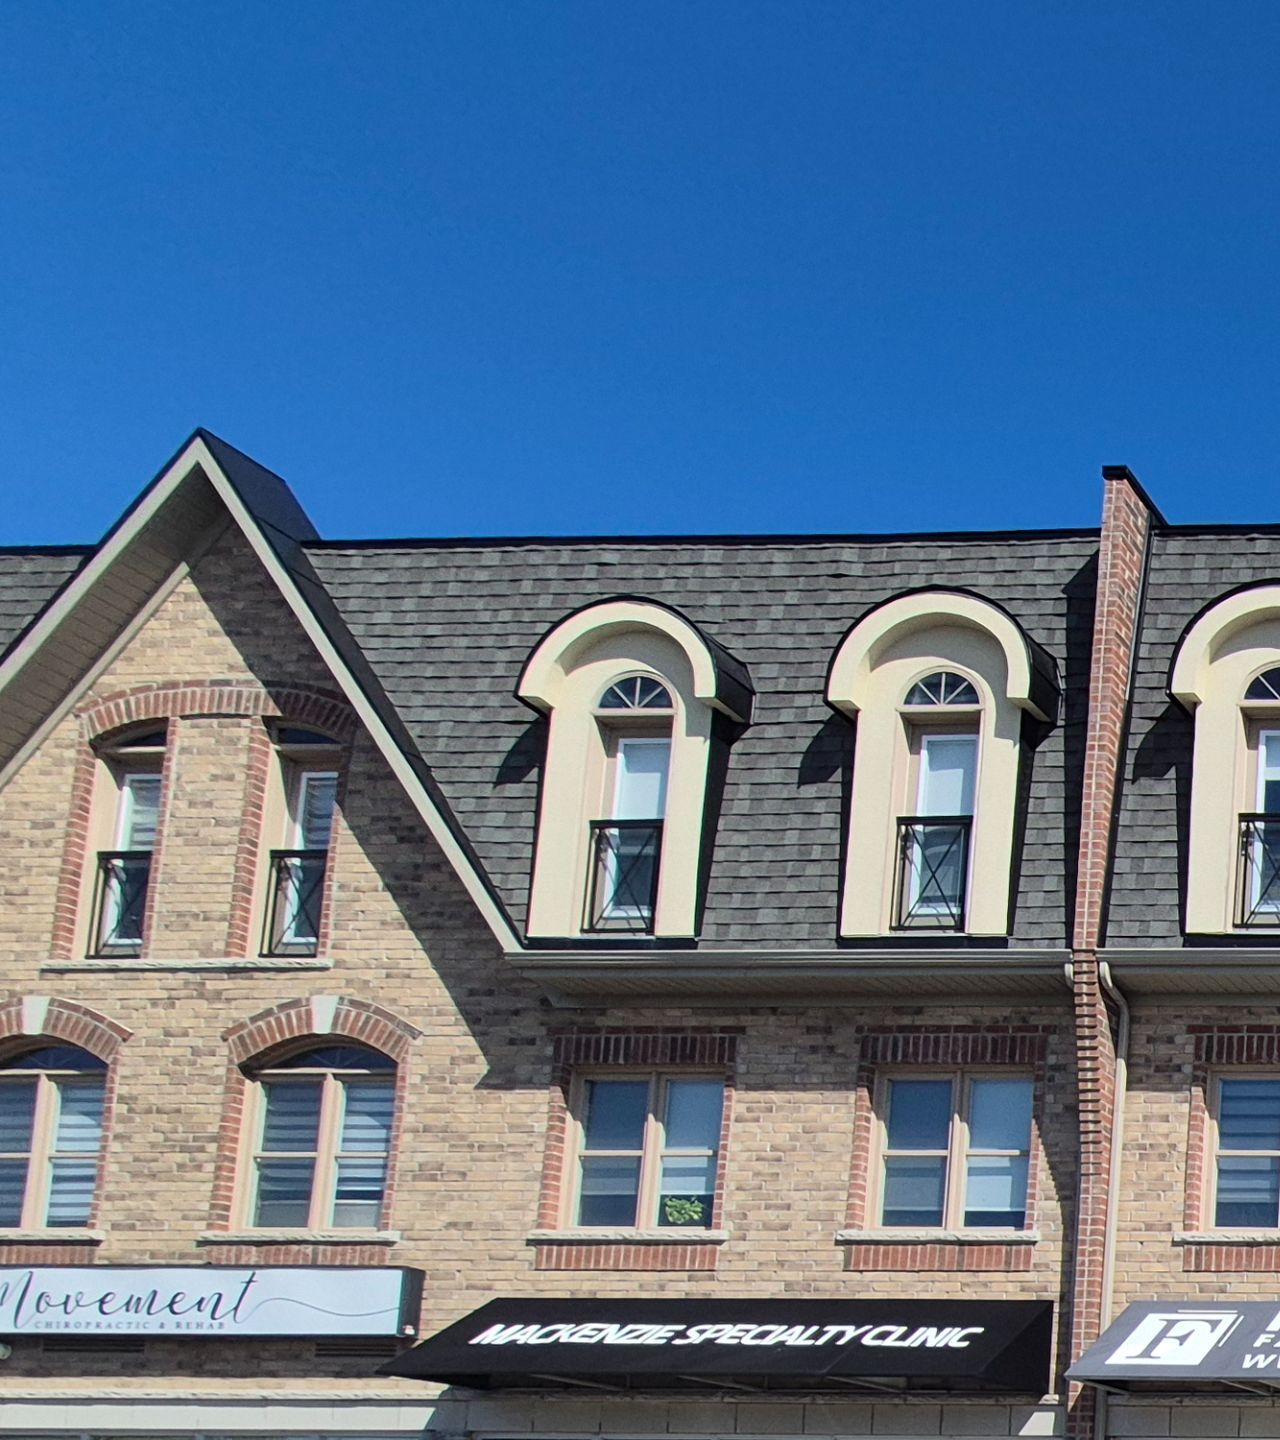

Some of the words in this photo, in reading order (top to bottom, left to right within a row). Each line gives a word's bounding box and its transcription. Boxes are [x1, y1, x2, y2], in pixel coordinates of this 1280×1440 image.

[34, 1321, 150, 1330] CHIROPRACTIC
[175, 1321, 226, 1330] REHAB
[468, 1323, 687, 1346] MACKENZIE
[671, 1323, 874, 1347] SPECIALTY
[861, 1325, 985, 1348] CLINIC
